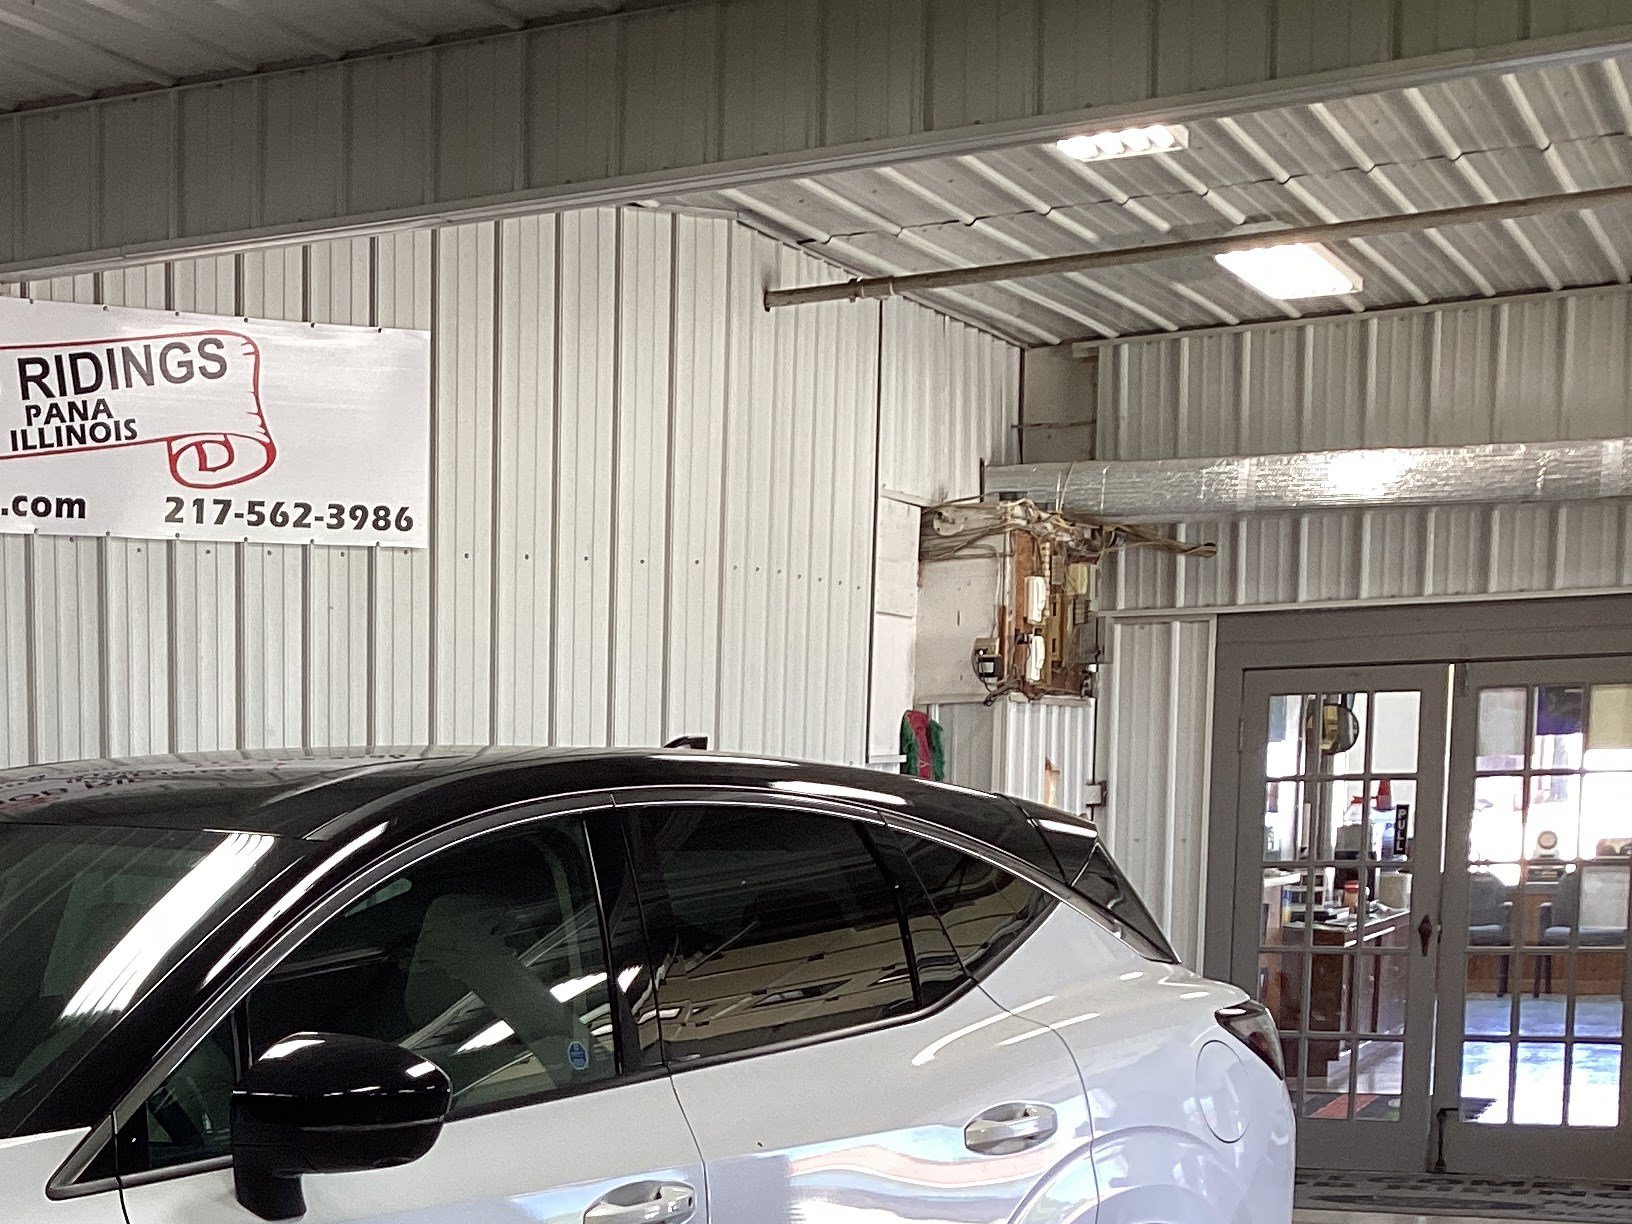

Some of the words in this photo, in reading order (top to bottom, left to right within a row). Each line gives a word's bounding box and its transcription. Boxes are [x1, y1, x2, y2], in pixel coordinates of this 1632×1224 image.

[19, 337, 229, 401] RIDINGS
[24, 399, 114, 427] PANA
[9, 419, 138, 453] ILLINOIS
[164, 496, 414, 534] 217-562-3986
[1396, 808, 1408, 852] PULL
